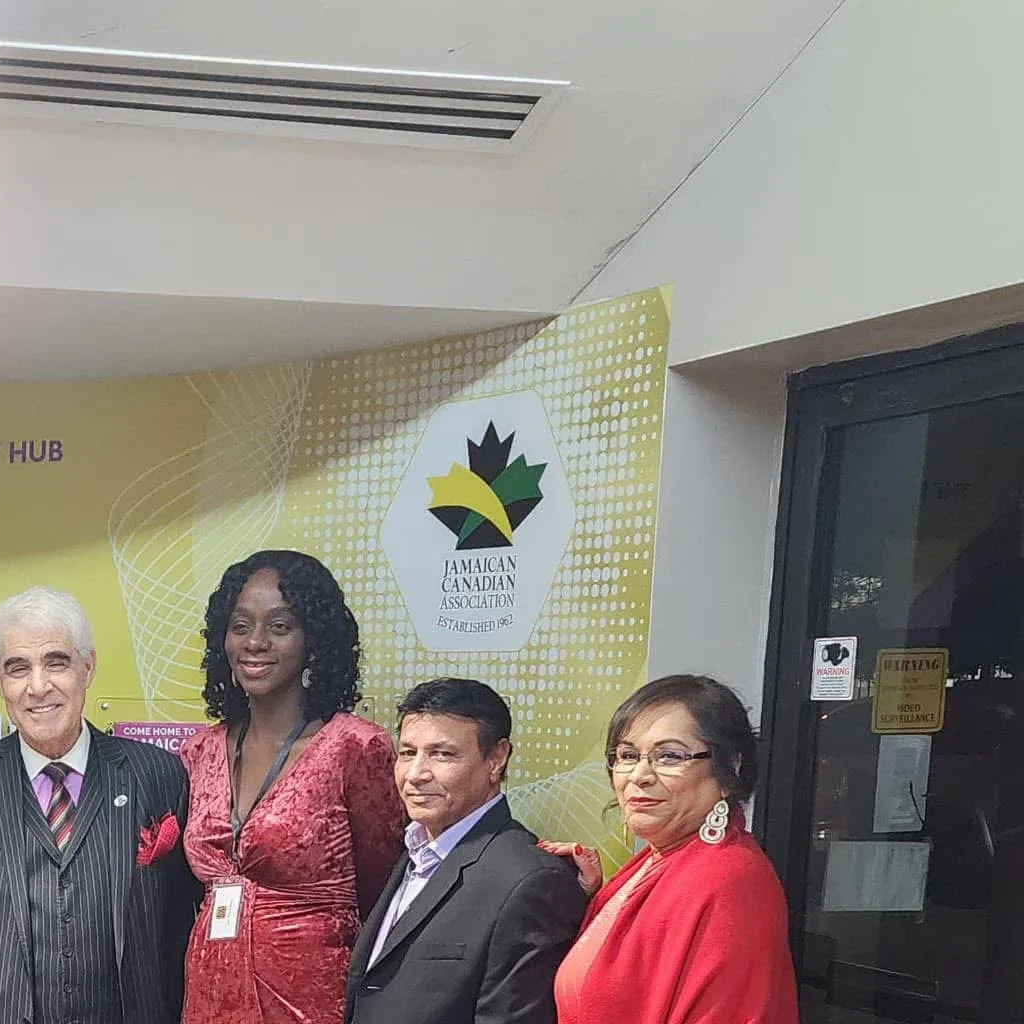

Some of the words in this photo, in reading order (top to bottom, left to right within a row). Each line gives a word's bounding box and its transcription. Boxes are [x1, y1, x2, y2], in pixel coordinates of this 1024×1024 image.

[8, 440, 64, 464] HUB
[443, 555, 517, 578] JAMAICAN
[441, 574, 516, 593] CANADIAN
[439, 593, 515, 610] ASSOCIATION
[436, 615, 496, 633] ESTABLISHED
[496, 613, 515, 630] 1962
[815, 667, 850, 676] WARNING
[896, 703, 922, 713] VIDEO
[123, 727, 151, 736] COME
[153, 727, 182, 736] HOME
[183, 727, 196, 736] TO
